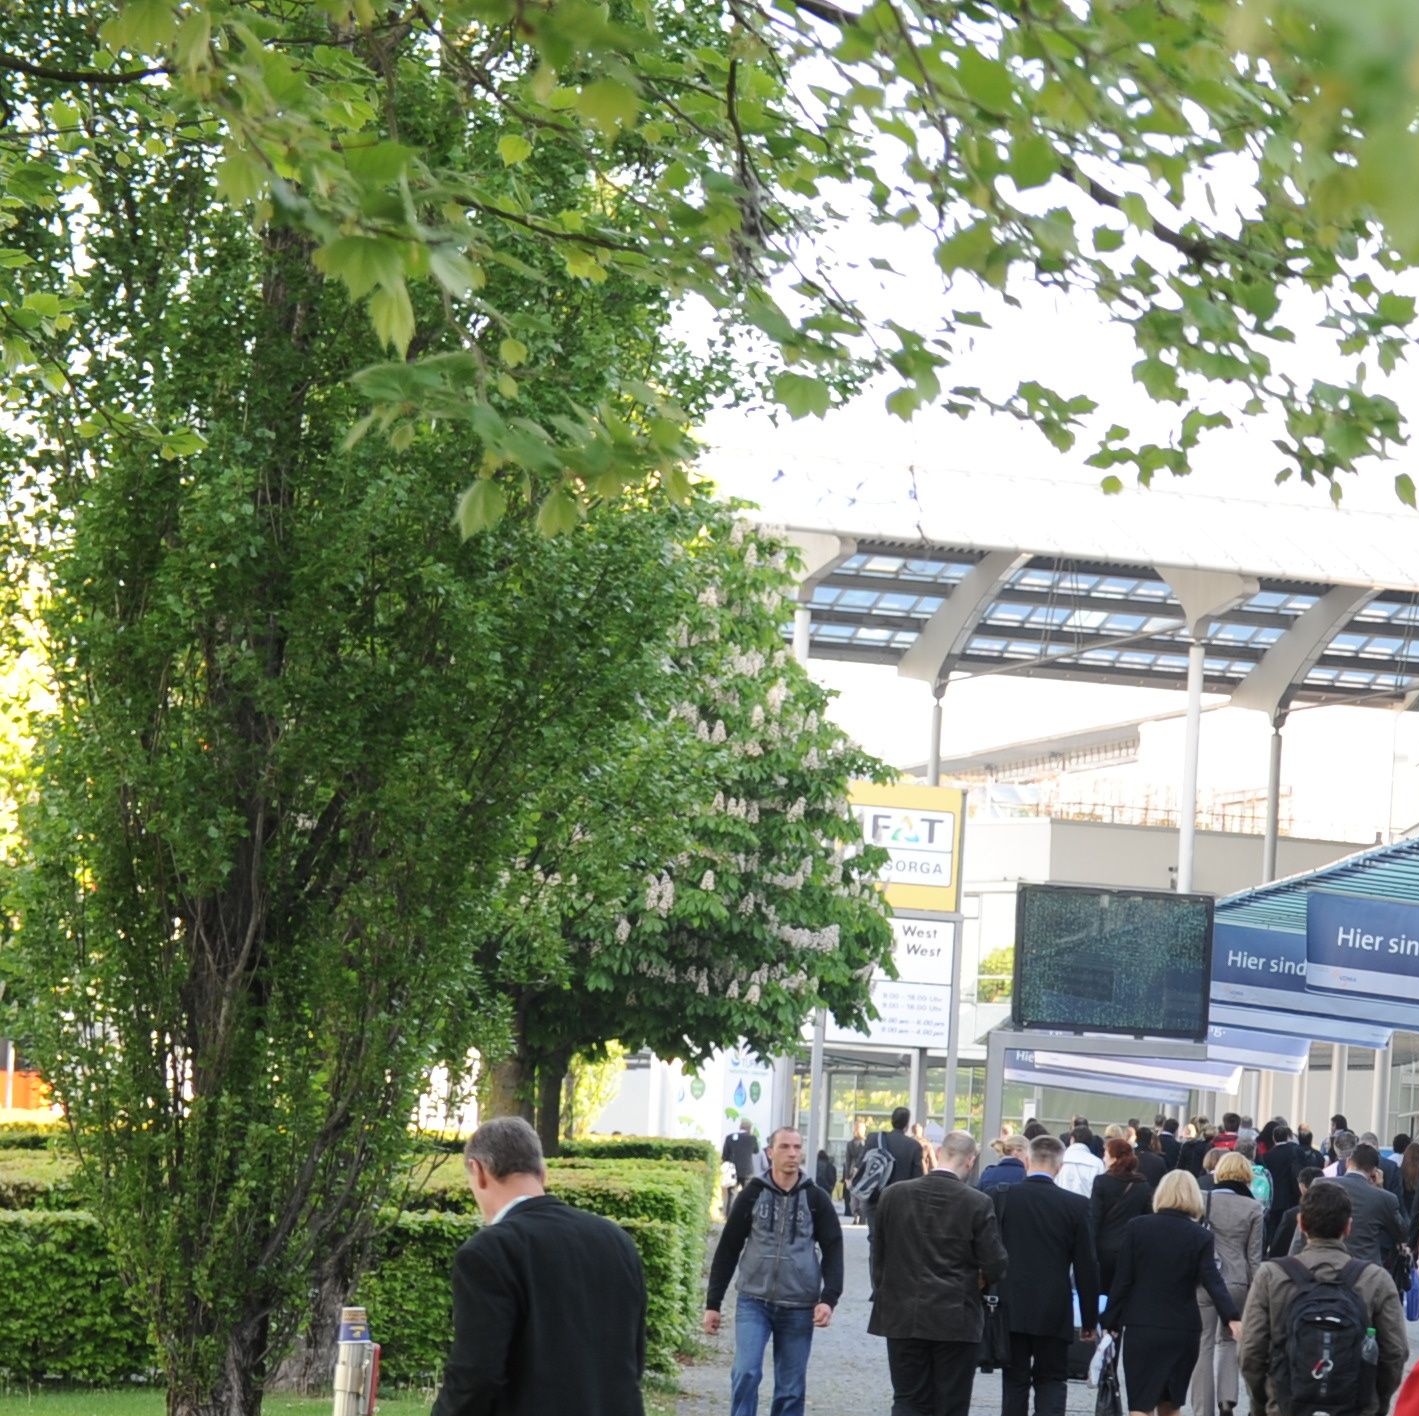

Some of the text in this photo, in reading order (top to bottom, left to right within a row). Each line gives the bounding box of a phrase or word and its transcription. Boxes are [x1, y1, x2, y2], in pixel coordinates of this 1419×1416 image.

[902, 925, 938, 939] West
[1337, 926, 1384, 951] Hier
[906, 943, 942, 957] West
[1227, 950, 1307, 976] Hier sind
